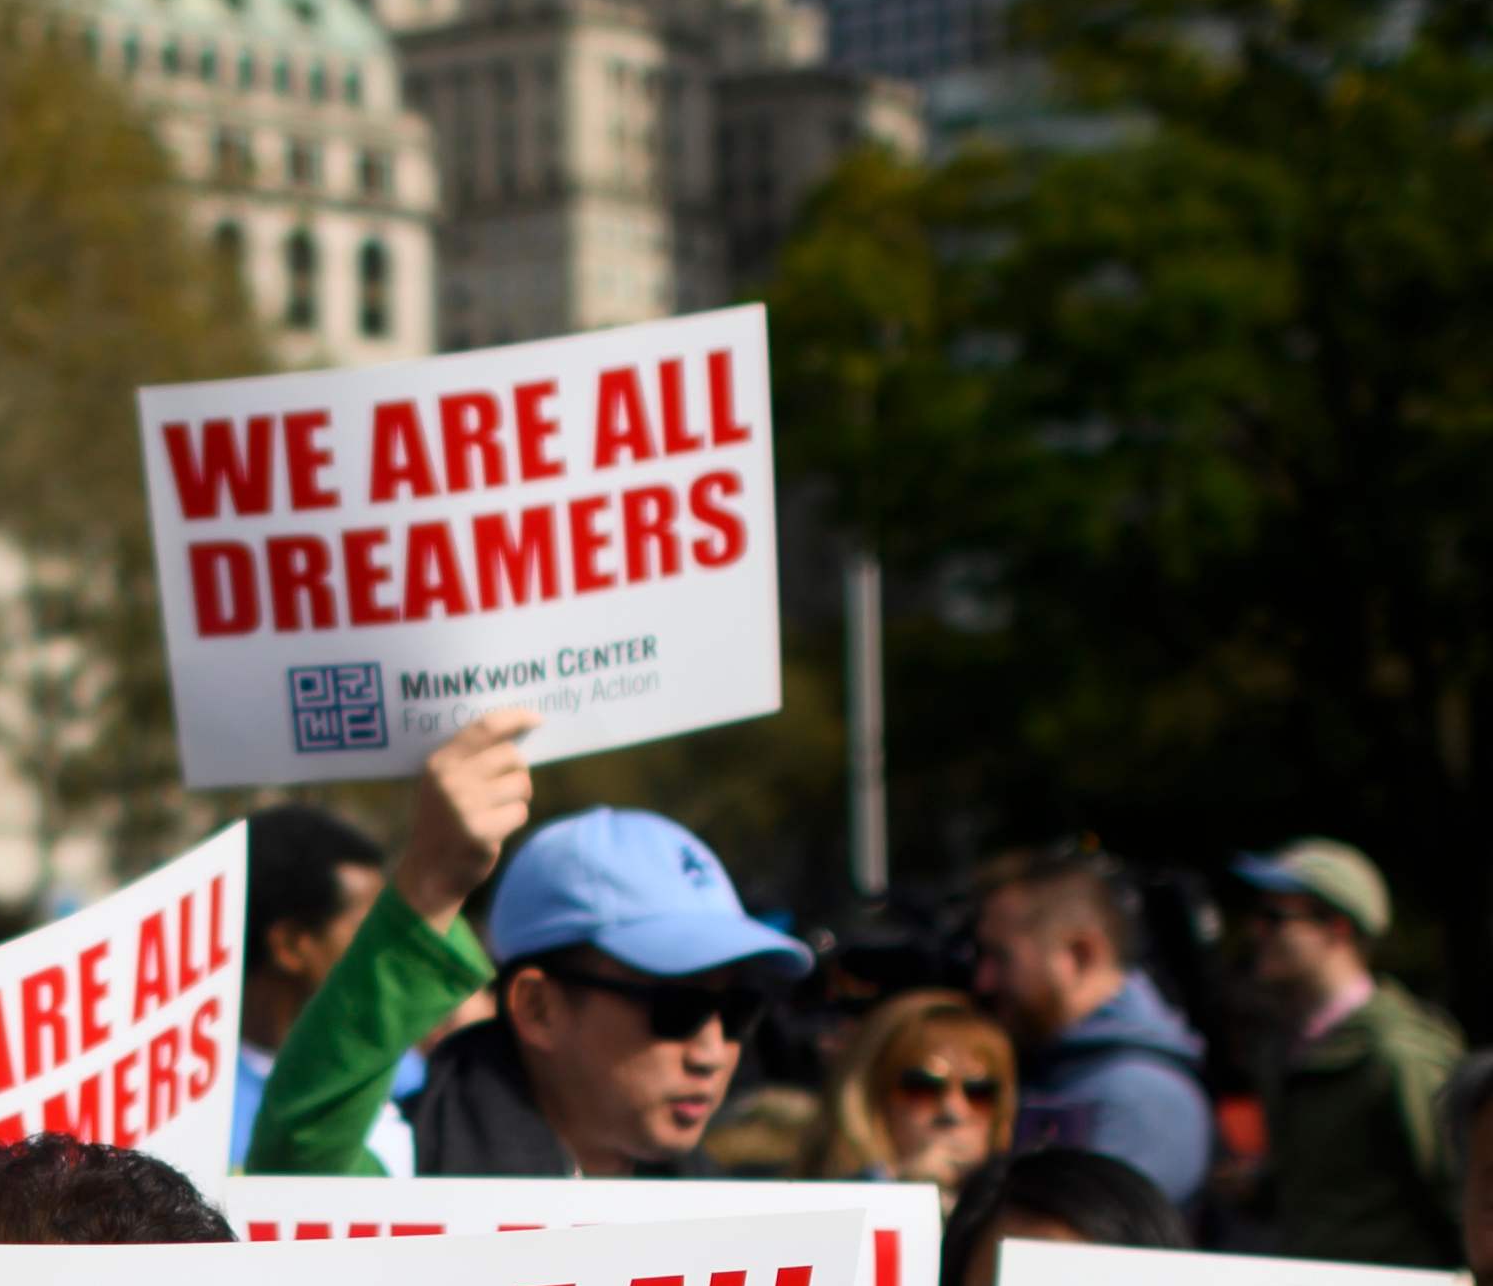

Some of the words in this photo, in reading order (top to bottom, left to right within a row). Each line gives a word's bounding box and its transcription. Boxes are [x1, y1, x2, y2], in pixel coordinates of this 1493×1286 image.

[162, 410, 340, 521] WE
[369, 379, 566, 504] ARE
[592, 349, 752, 470] ALL
[188, 468, 748, 639] DREAMERS
[403, 707, 442, 732] For
[591, 670, 660, 704] Action
[132, 875, 230, 1024] ALL
